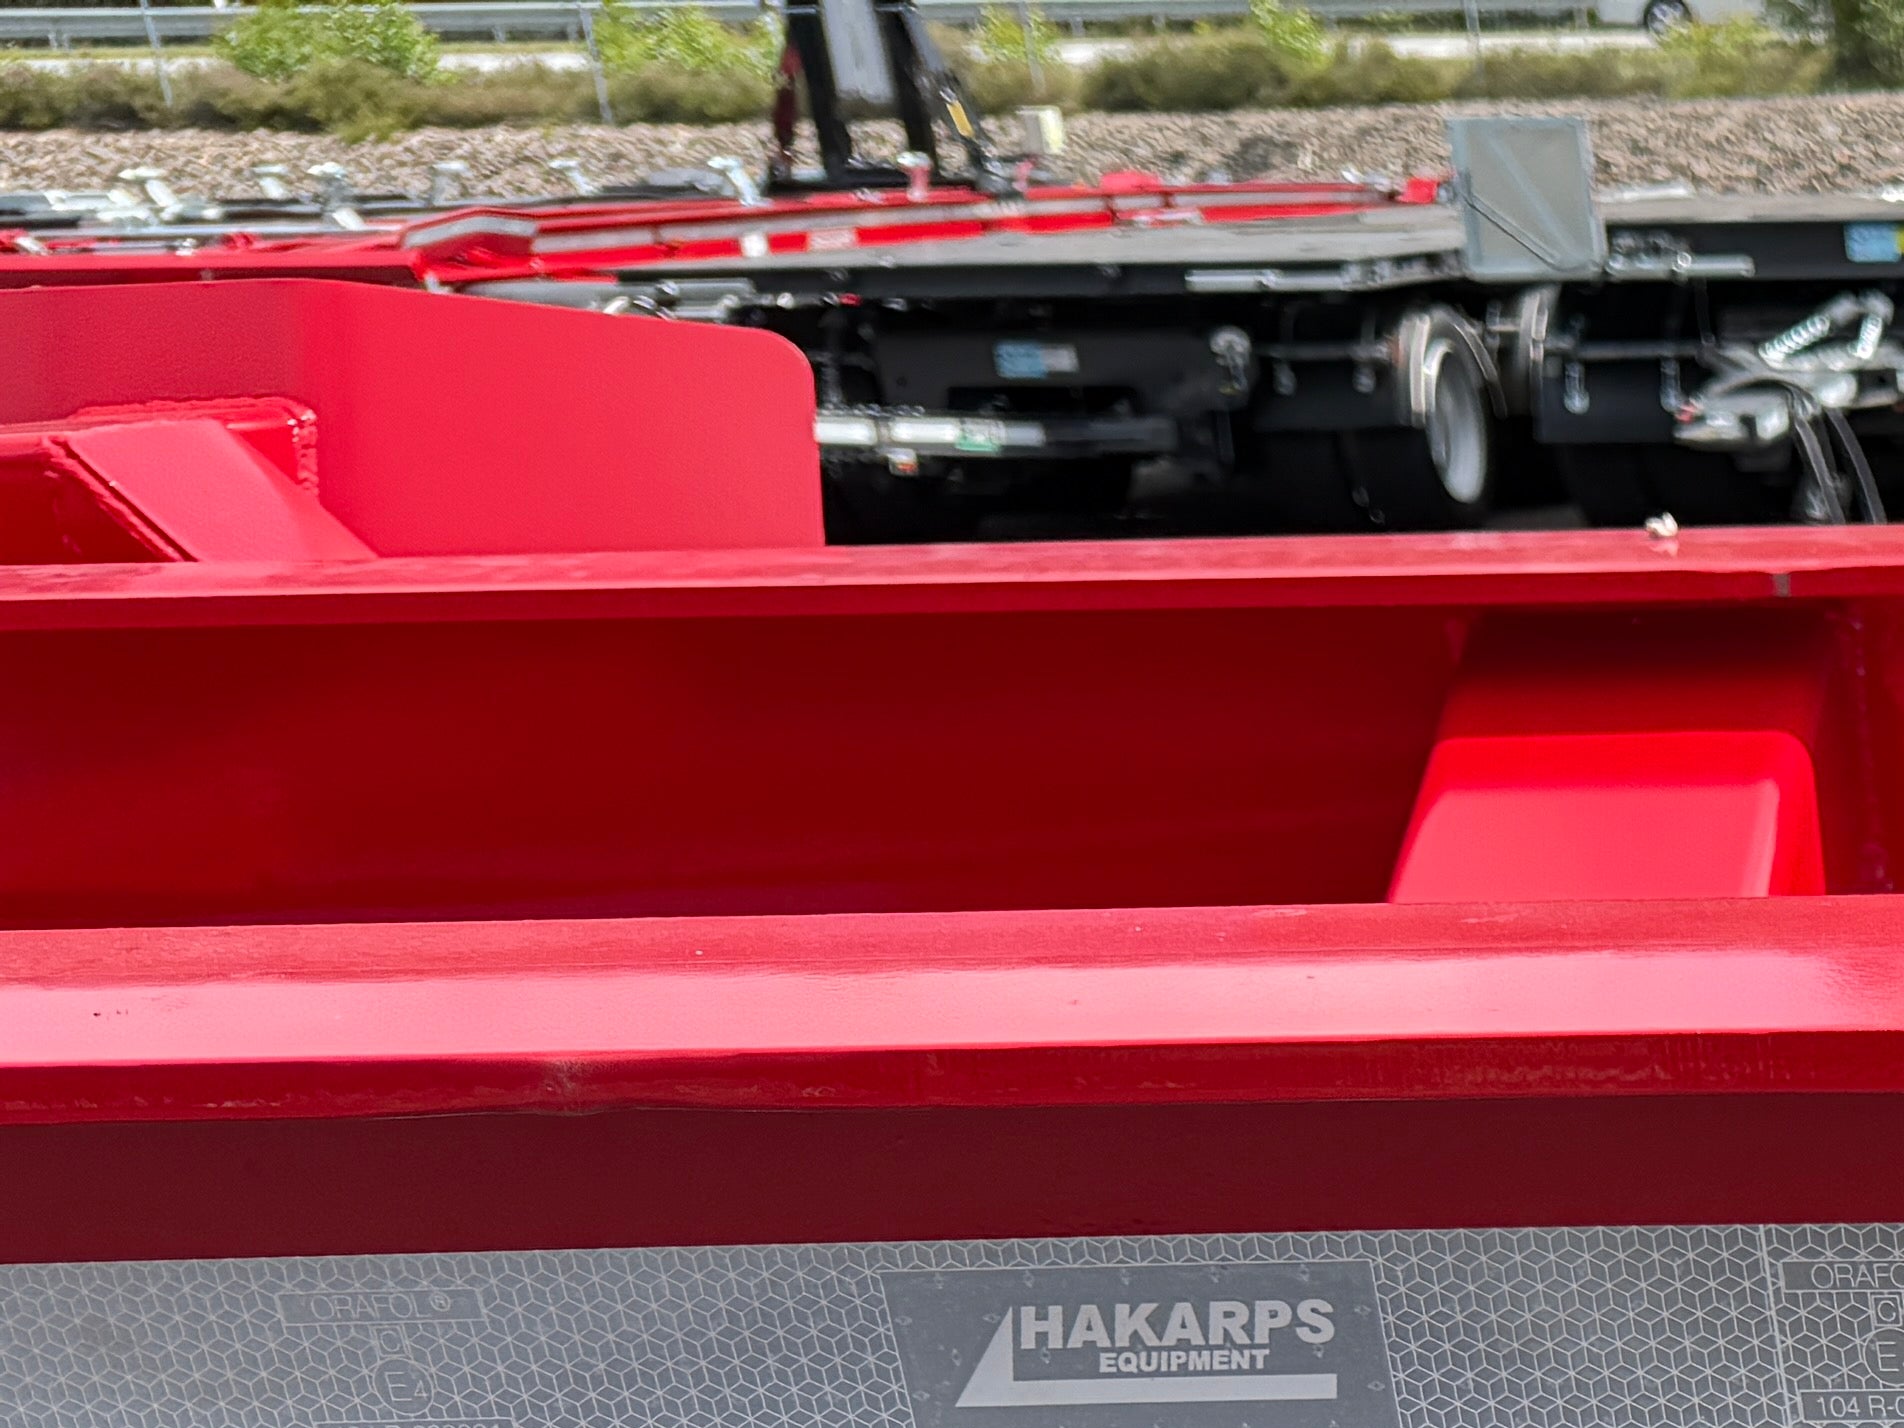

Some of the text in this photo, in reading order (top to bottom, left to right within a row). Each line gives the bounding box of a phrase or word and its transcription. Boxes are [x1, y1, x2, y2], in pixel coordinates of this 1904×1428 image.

[1877, 1299, 1897, 1322] C
[1019, 1298, 1337, 1350] HAKARPS
[379, 1330, 401, 1352] C
[1099, 1348, 1270, 1374] EQUIPMENT
[1816, 1394, 1861, 1418] 104
